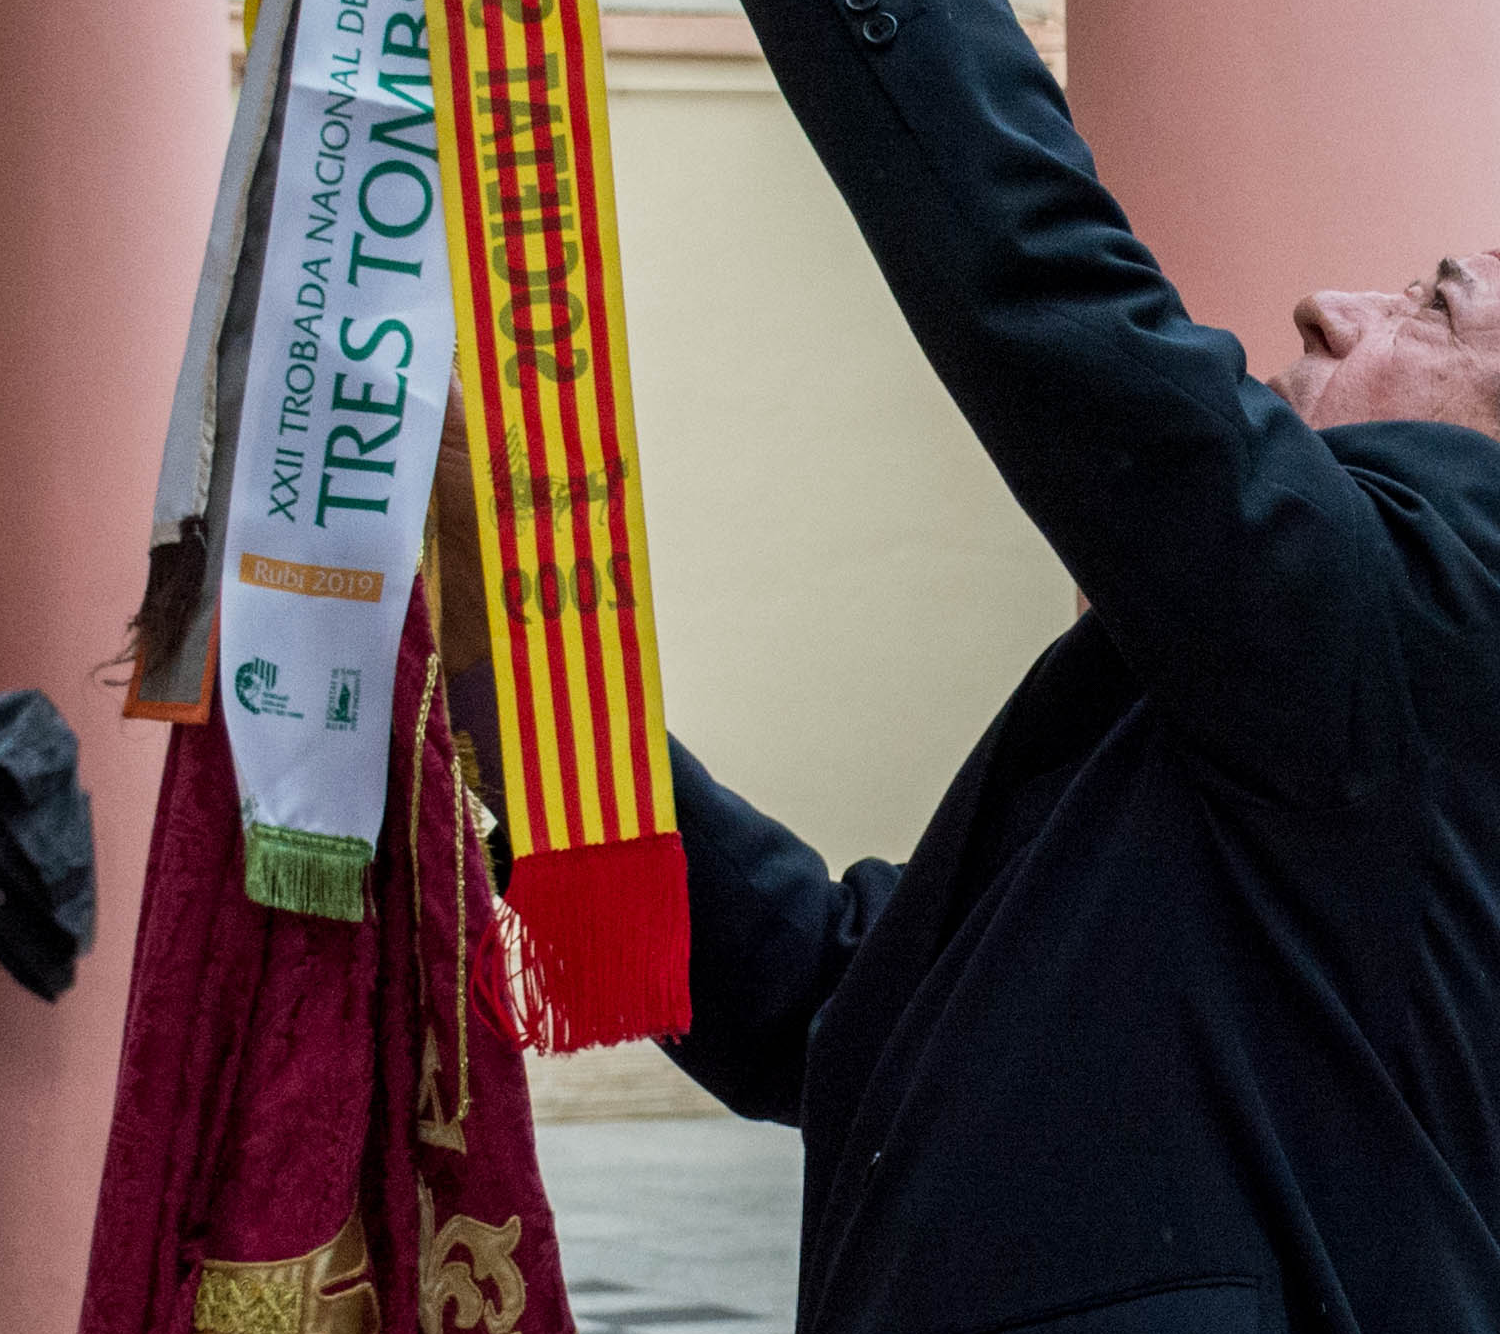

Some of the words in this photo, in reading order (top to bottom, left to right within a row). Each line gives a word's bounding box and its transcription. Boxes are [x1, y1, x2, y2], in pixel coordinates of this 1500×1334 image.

[304, 48, 364, 244] NACIONAL
[278, 256, 331, 436] TROBADA
[314, 316, 414, 529] TRES
[267, 447, 306, 522] XXII
[312, 570, 374, 595] 2019
